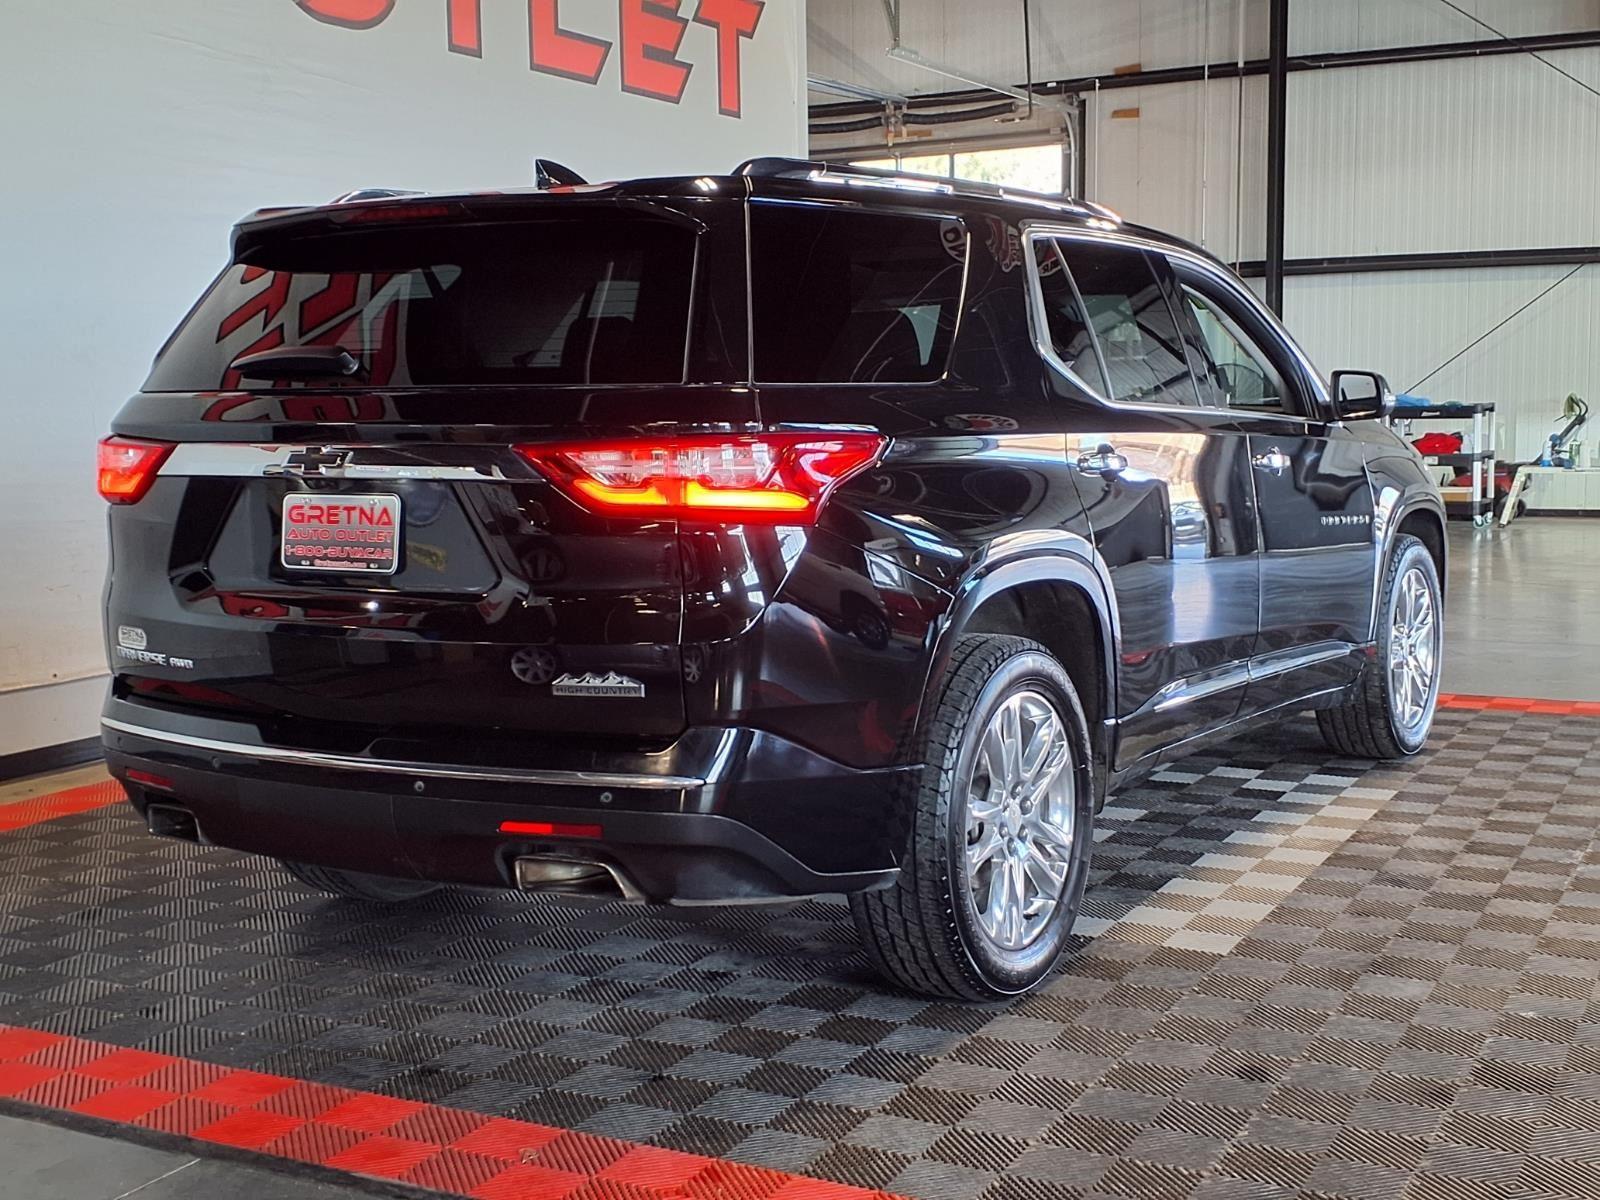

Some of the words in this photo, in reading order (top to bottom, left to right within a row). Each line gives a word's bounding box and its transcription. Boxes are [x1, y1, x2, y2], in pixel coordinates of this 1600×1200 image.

[288, 504, 394, 526] GRETNA
[286, 528, 331, 541] AUTO
[335, 529, 394, 543] OUTLET
[285, 545, 393, 559] 1-800-BUYACAR
[555, 685, 583, 695] HIGH
[587, 685, 639, 696] COUNTRY
